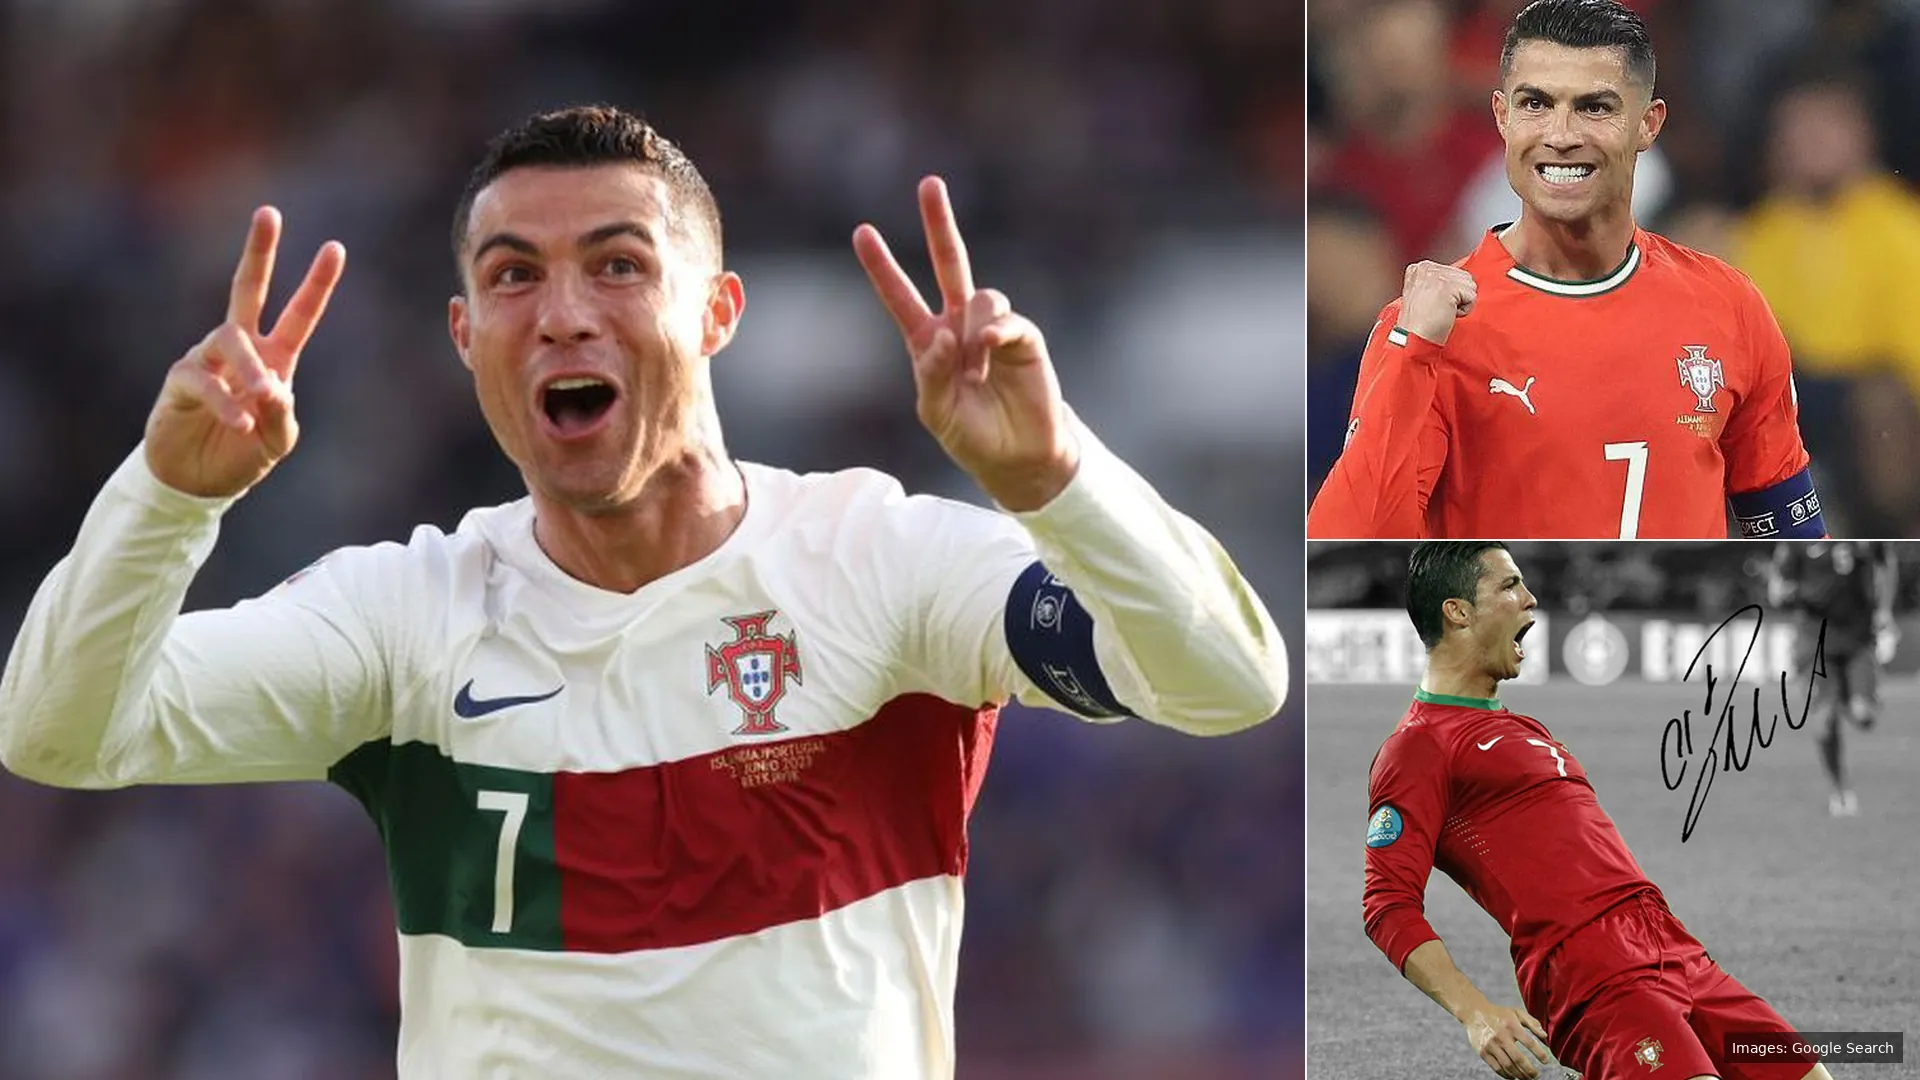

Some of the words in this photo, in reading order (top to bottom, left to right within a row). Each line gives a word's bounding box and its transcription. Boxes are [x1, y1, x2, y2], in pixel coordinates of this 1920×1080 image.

[1603, 441, 1648, 539] 7
[1526, 738, 1567, 777] 7
[477, 790, 530, 934] 7
